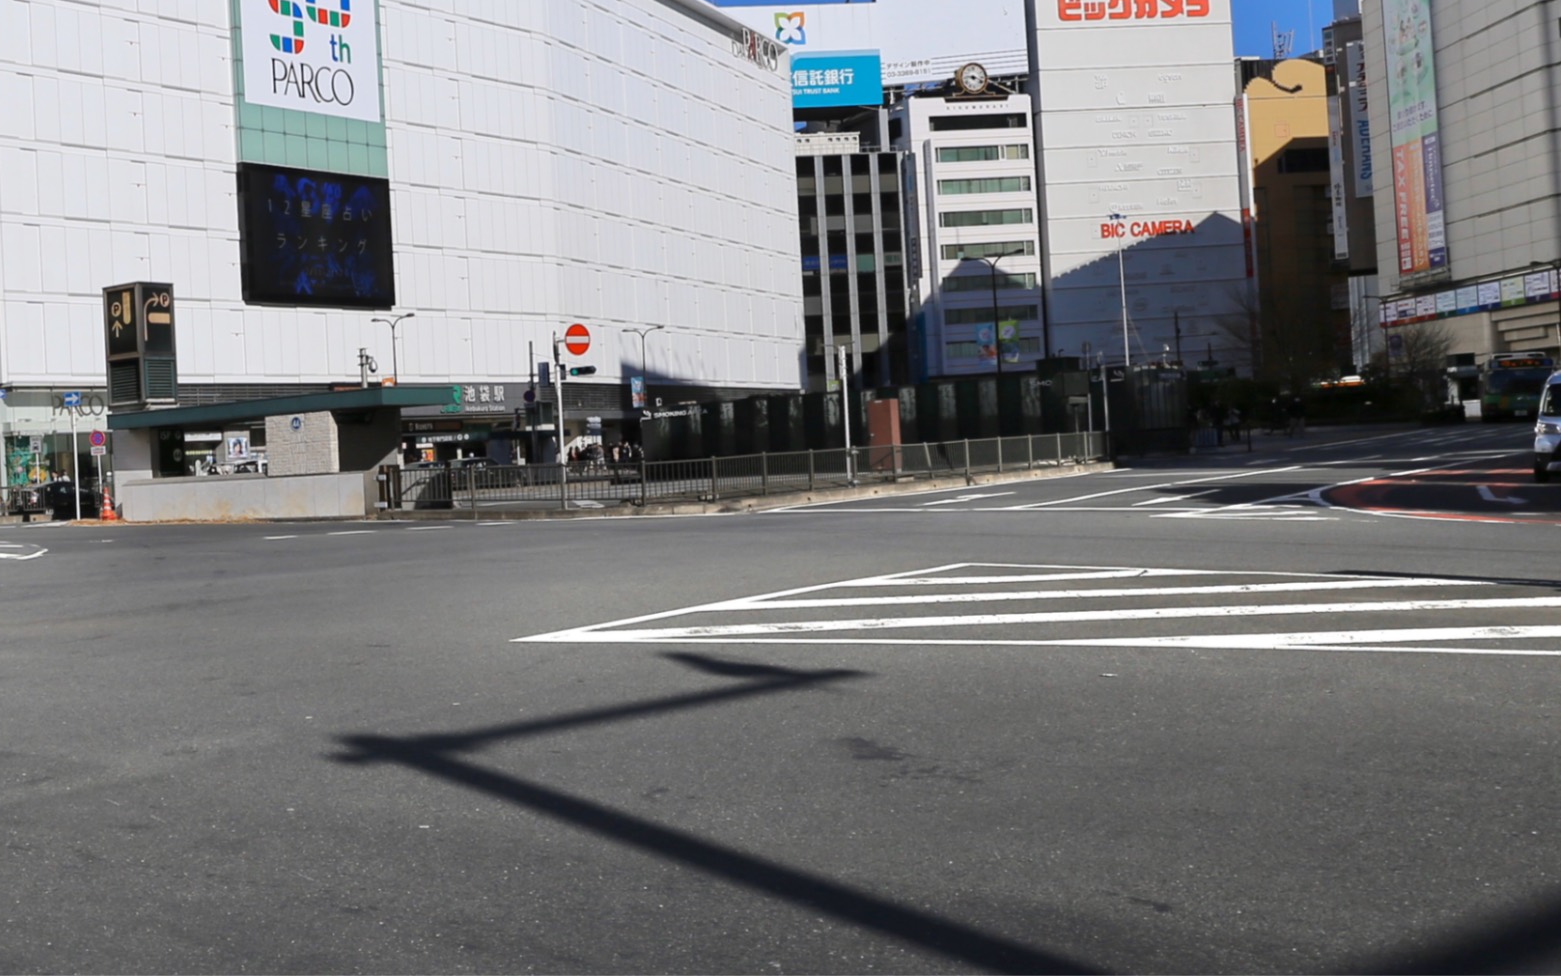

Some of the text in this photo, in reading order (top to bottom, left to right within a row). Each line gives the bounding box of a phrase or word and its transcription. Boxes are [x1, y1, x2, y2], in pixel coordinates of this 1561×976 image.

[741, 27, 779, 72] PARCO
[271, 58, 355, 106] PARCO
[790, 68, 854, 87] 信託銀行
[1396, 149, 1408, 187] TAX
[1100, 219, 1196, 239] BIC CAMERA
[1399, 191, 1409, 240] FREE
[277, 232, 368, 256] ランキング
[464, 384, 505, 403] 池袋駅
